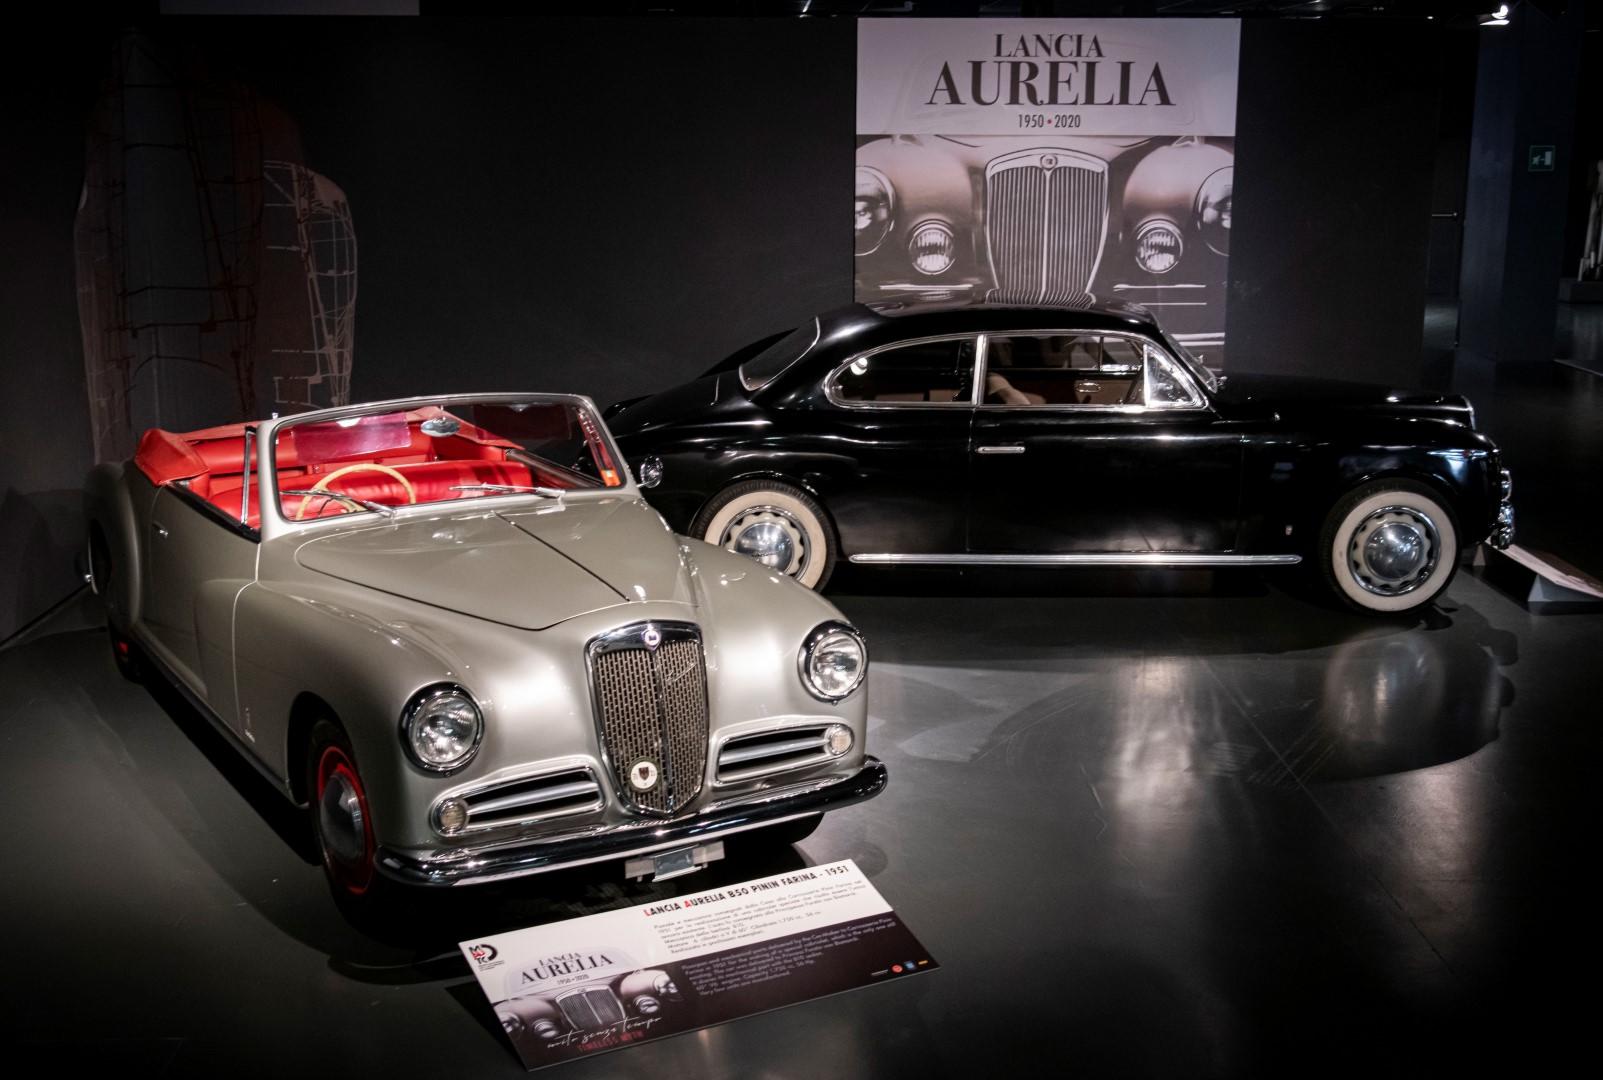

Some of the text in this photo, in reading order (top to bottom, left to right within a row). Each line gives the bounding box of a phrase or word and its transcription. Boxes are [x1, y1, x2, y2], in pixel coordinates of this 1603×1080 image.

[995, 33, 1106, 58] LANCIA
[925, 60, 1177, 106] AURELIA
[1018, 114, 1081, 128] 1950 2020
[643, 902, 682, 917] LANCIA
[683, 892, 726, 908] AURELIA
[749, 880, 780, 893] PININ
[780, 872, 818, 886] FARINA
[825, 864, 849, 876] 1951
[522, 954, 613, 985] AURELIA
[538, 952, 582, 967] LANCIA
